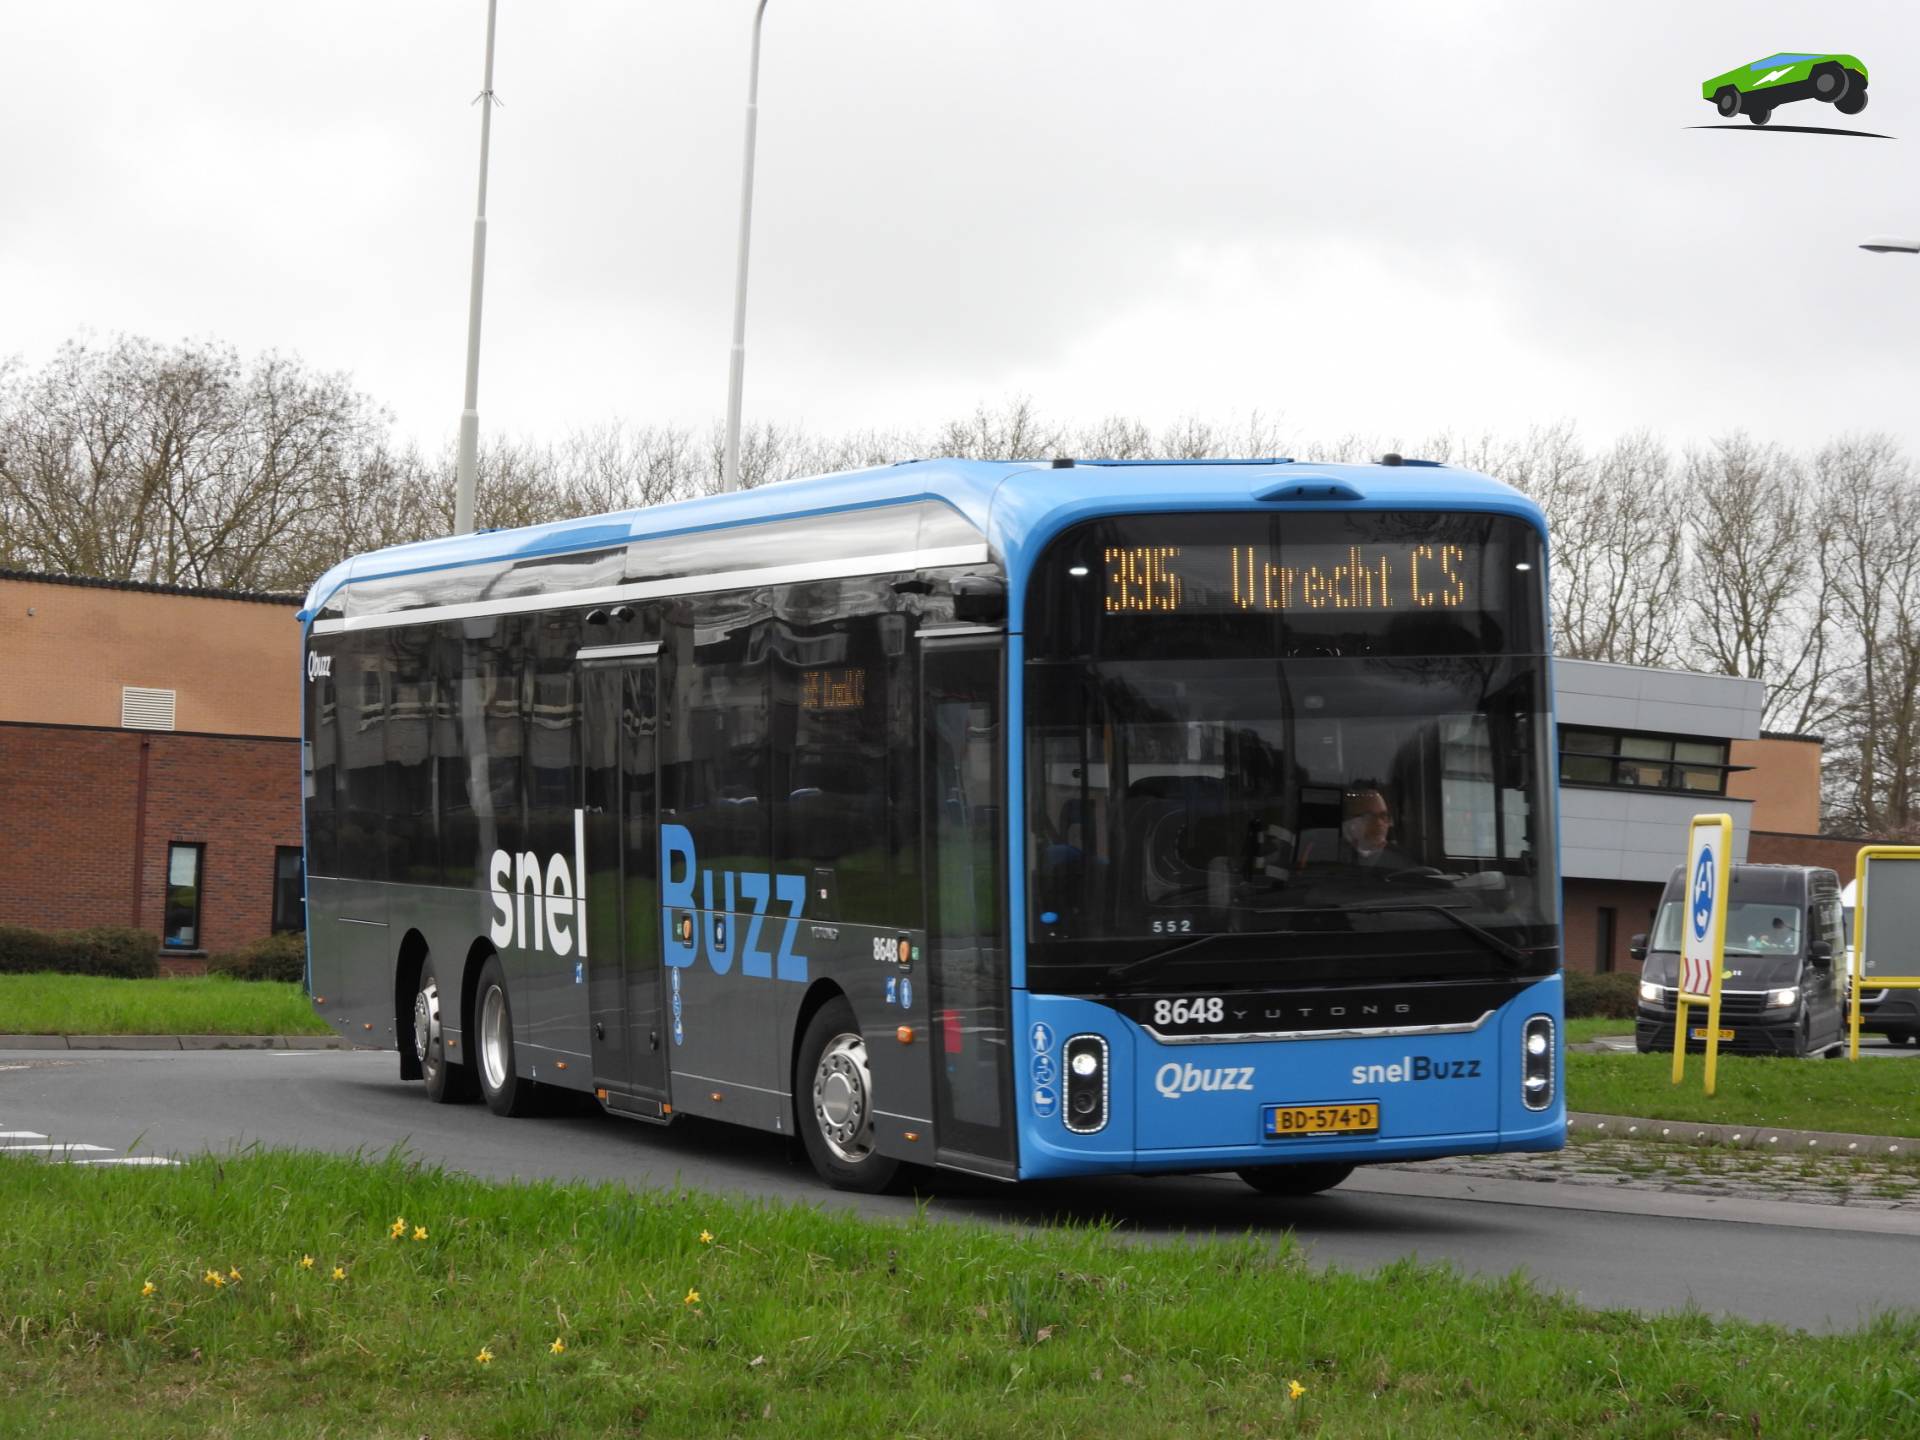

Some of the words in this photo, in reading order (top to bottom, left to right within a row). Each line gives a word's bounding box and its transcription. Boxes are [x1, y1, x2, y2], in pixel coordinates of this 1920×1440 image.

[1104, 547, 1182, 611] 395
[1231, 546, 1394, 608] Utrecht
[1411, 545, 1465, 606] CS
[308, 650, 332, 682] Qbuzz
[490, 808, 589, 958] snel
[661, 823, 809, 983] Buzz
[873, 936, 899, 962] 8648
[1153, 997, 1225, 1025] 8648
[1232, 1003, 1411, 1020] YUTONG
[1154, 1062, 1255, 1098] Qbuzz
[1351, 1055, 1481, 1085] snelBuzz
[1281, 1108, 1371, 1130] BD-574-D
